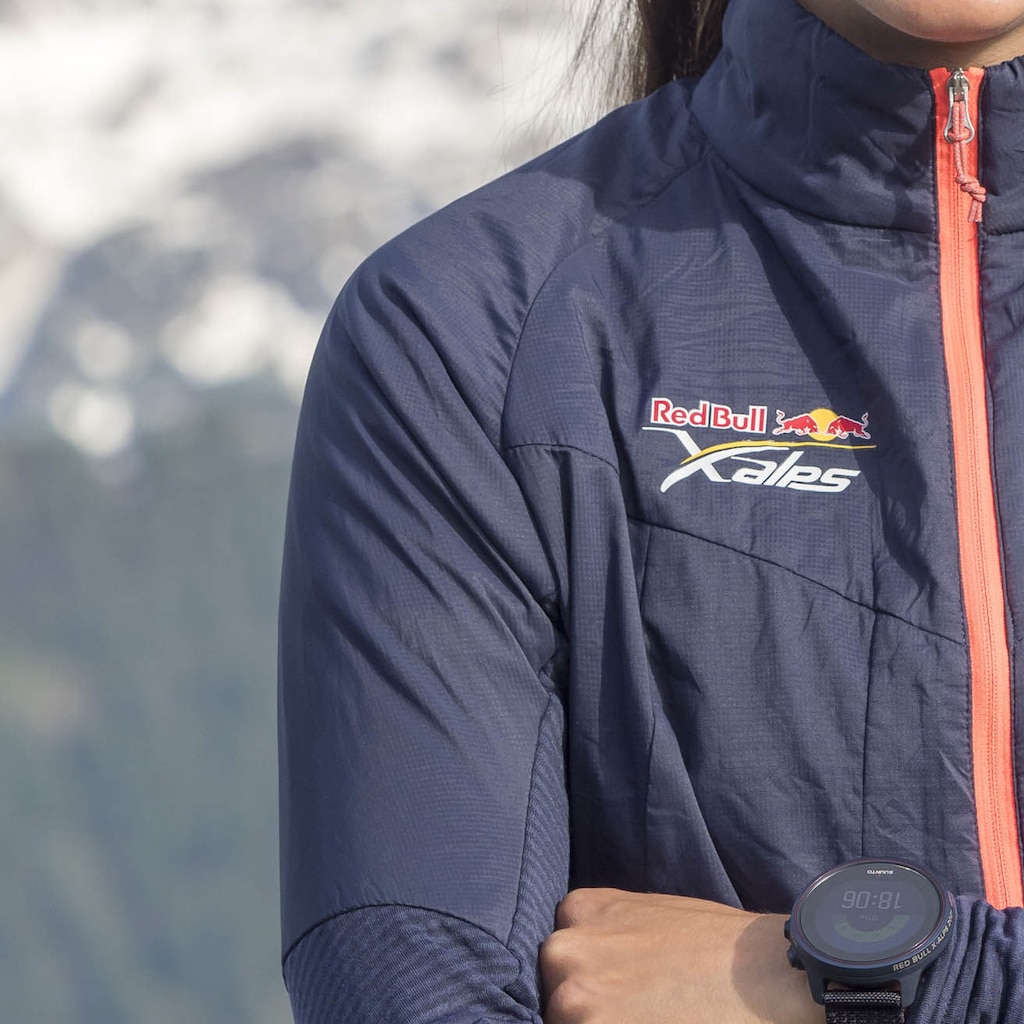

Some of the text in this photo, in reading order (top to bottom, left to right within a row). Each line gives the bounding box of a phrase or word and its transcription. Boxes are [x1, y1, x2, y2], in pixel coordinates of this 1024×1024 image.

[651, 397, 767, 434] Red Bull
[841, 890, 903, 910] 18:06
[892, 959, 911, 972] RED
[912, 947, 932, 964] BULL
